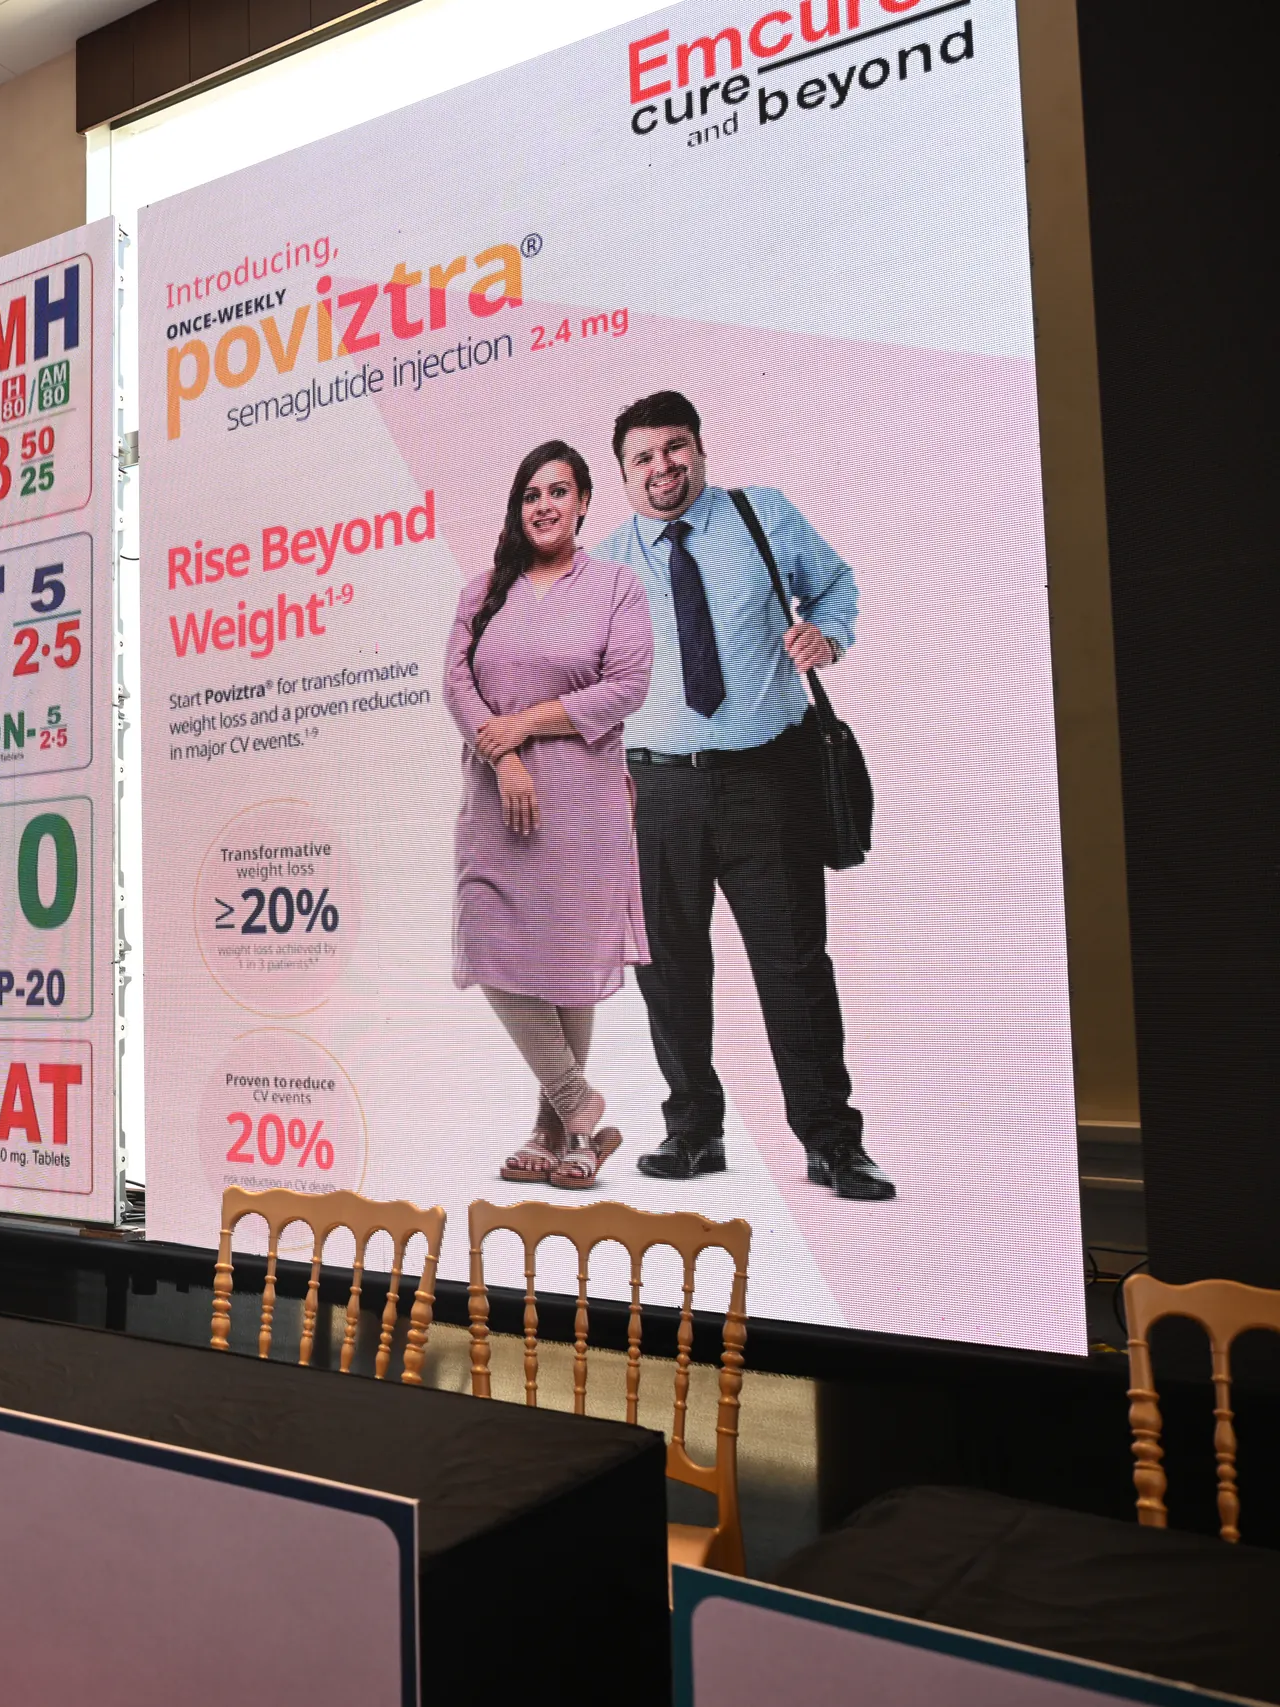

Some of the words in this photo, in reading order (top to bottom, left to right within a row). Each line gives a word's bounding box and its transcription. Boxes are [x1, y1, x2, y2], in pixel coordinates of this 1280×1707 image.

[758, 19, 974, 125] beyond
[631, 72, 750, 135] cure
[687, 111, 739, 147] and
[166, 234, 340, 308] Introducing,
[166, 288, 287, 340] ONCE-WEEKLY
[226, 360, 384, 432] semaglutide
[392, 330, 513, 388] injection
[530, 319, 572, 352] 2.4
[580, 306, 629, 341] mg
[21, 425, 55, 460] 50
[20, 461, 55, 497] 25
[168, 539, 250, 590] Rise
[262, 489, 436, 576] Beyond
[30, 563, 66, 612] 5
[170, 692, 201, 710] Start
[278, 677, 298, 695] for
[302, 661, 419, 692] transformative
[47, 705, 61, 725] 5
[170, 715, 217, 737] weight
[219, 709, 247, 729] loss
[250, 704, 279, 724] and
[282, 707, 291, 722] a
[295, 697, 349, 723] proven
[352, 687, 431, 711] reduction
[170, 742, 182, 760] in
[185, 737, 227, 762] major
[230, 736, 250, 753] CV
[221, 842, 332, 862] Transformative
[236, 863, 283, 882] weight
[288, 862, 315, 876] loss
[226, 1073, 269, 1088] Proven
[274, 1076, 286, 1088] to
[289, 1076, 335, 1091] reduce
[253, 1090, 268, 1103] CV
[272, 1092, 312, 1105] events
[32, 1150, 70, 1167] Tablets
[226, 1111, 334, 1170] 20%
